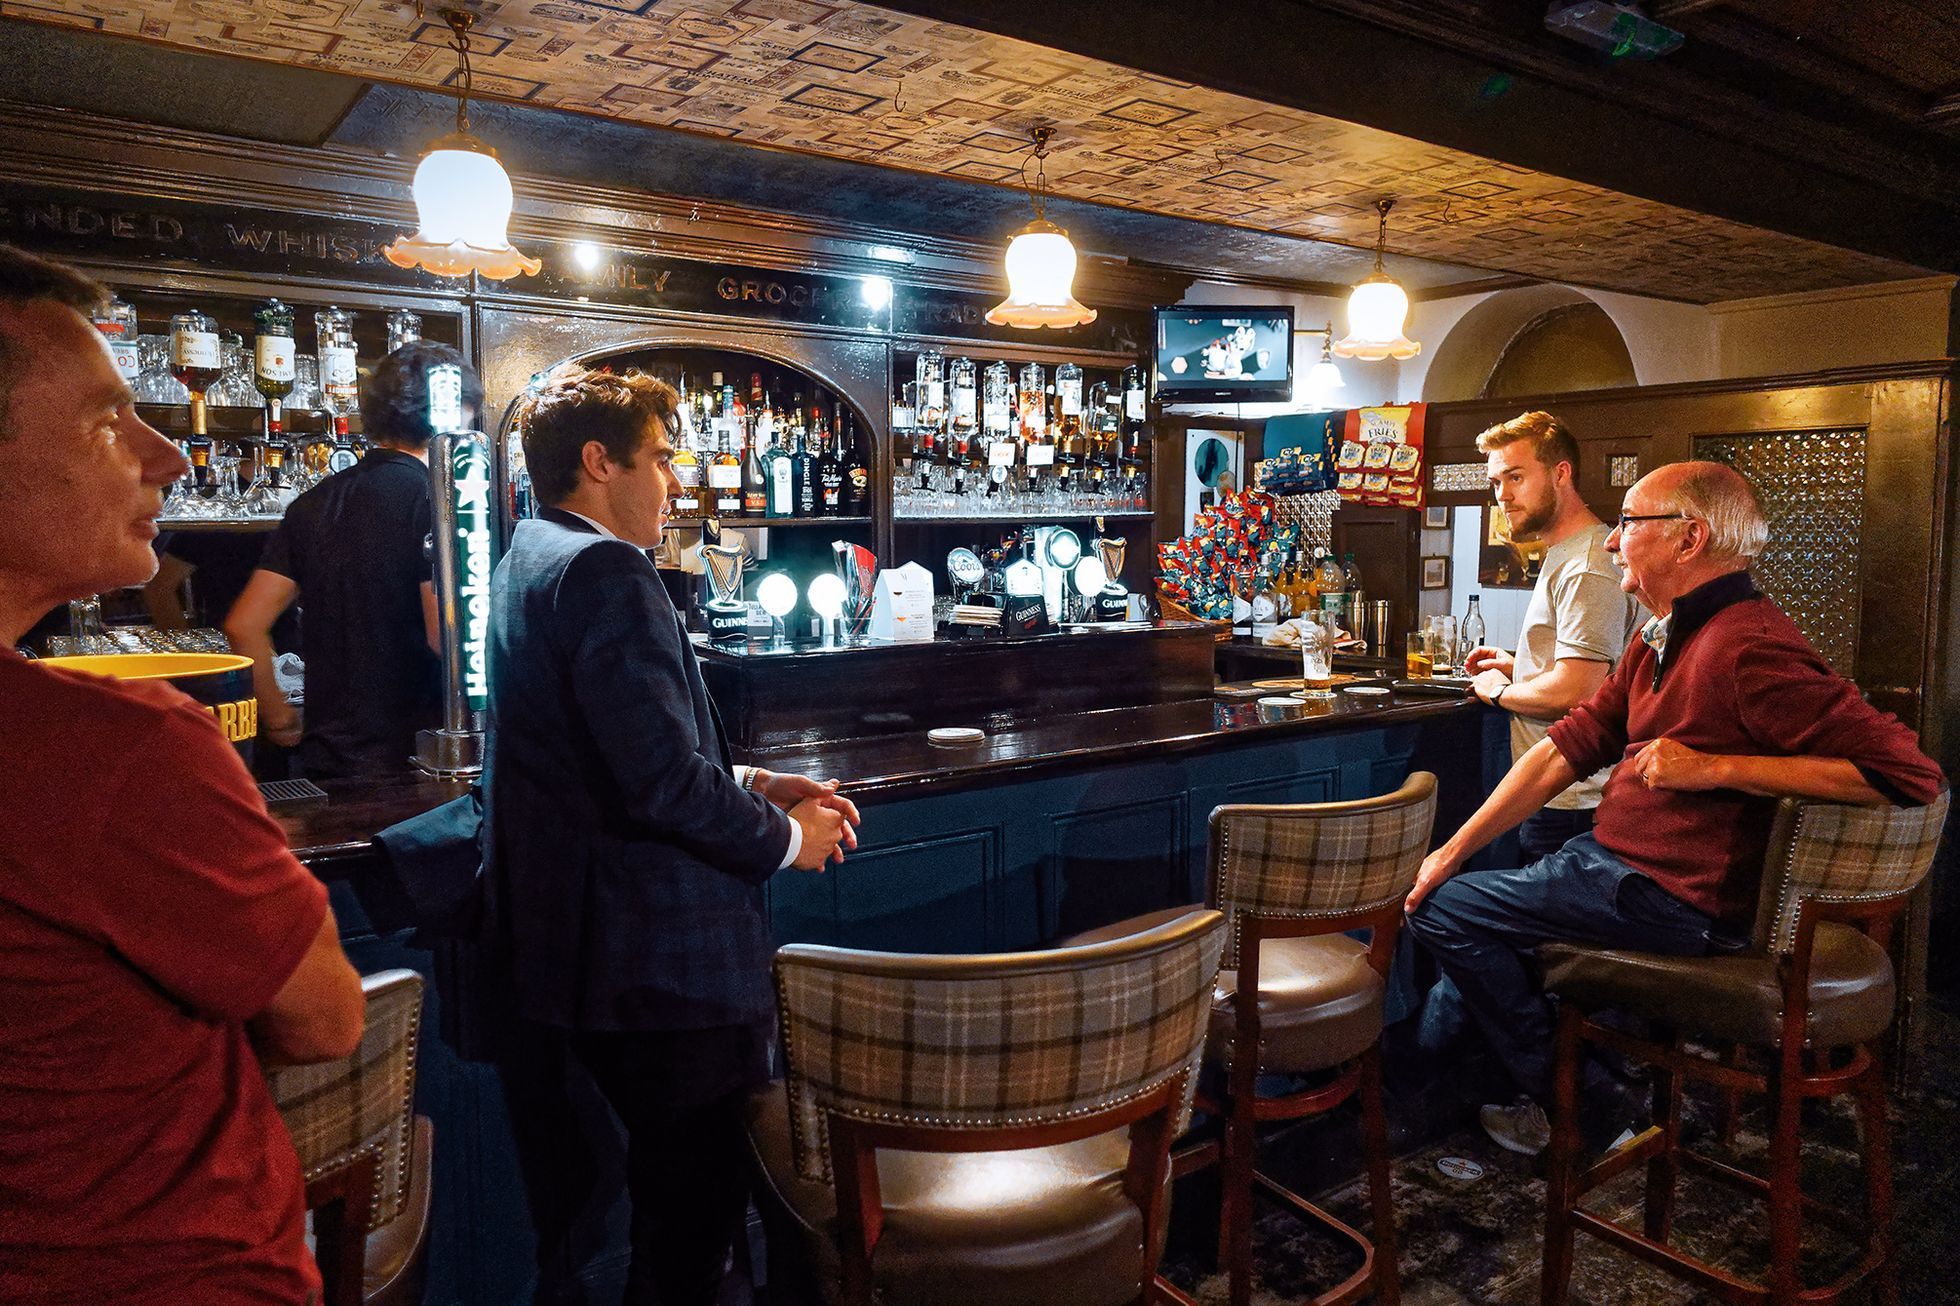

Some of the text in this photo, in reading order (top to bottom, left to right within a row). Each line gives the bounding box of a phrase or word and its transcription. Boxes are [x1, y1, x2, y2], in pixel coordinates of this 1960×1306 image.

[0, 205, 184, 241] NDED
[803, 457, 811, 486] DINGLE
[952, 560, 982, 573] Coors
[463, 530, 490, 697] Heineken
